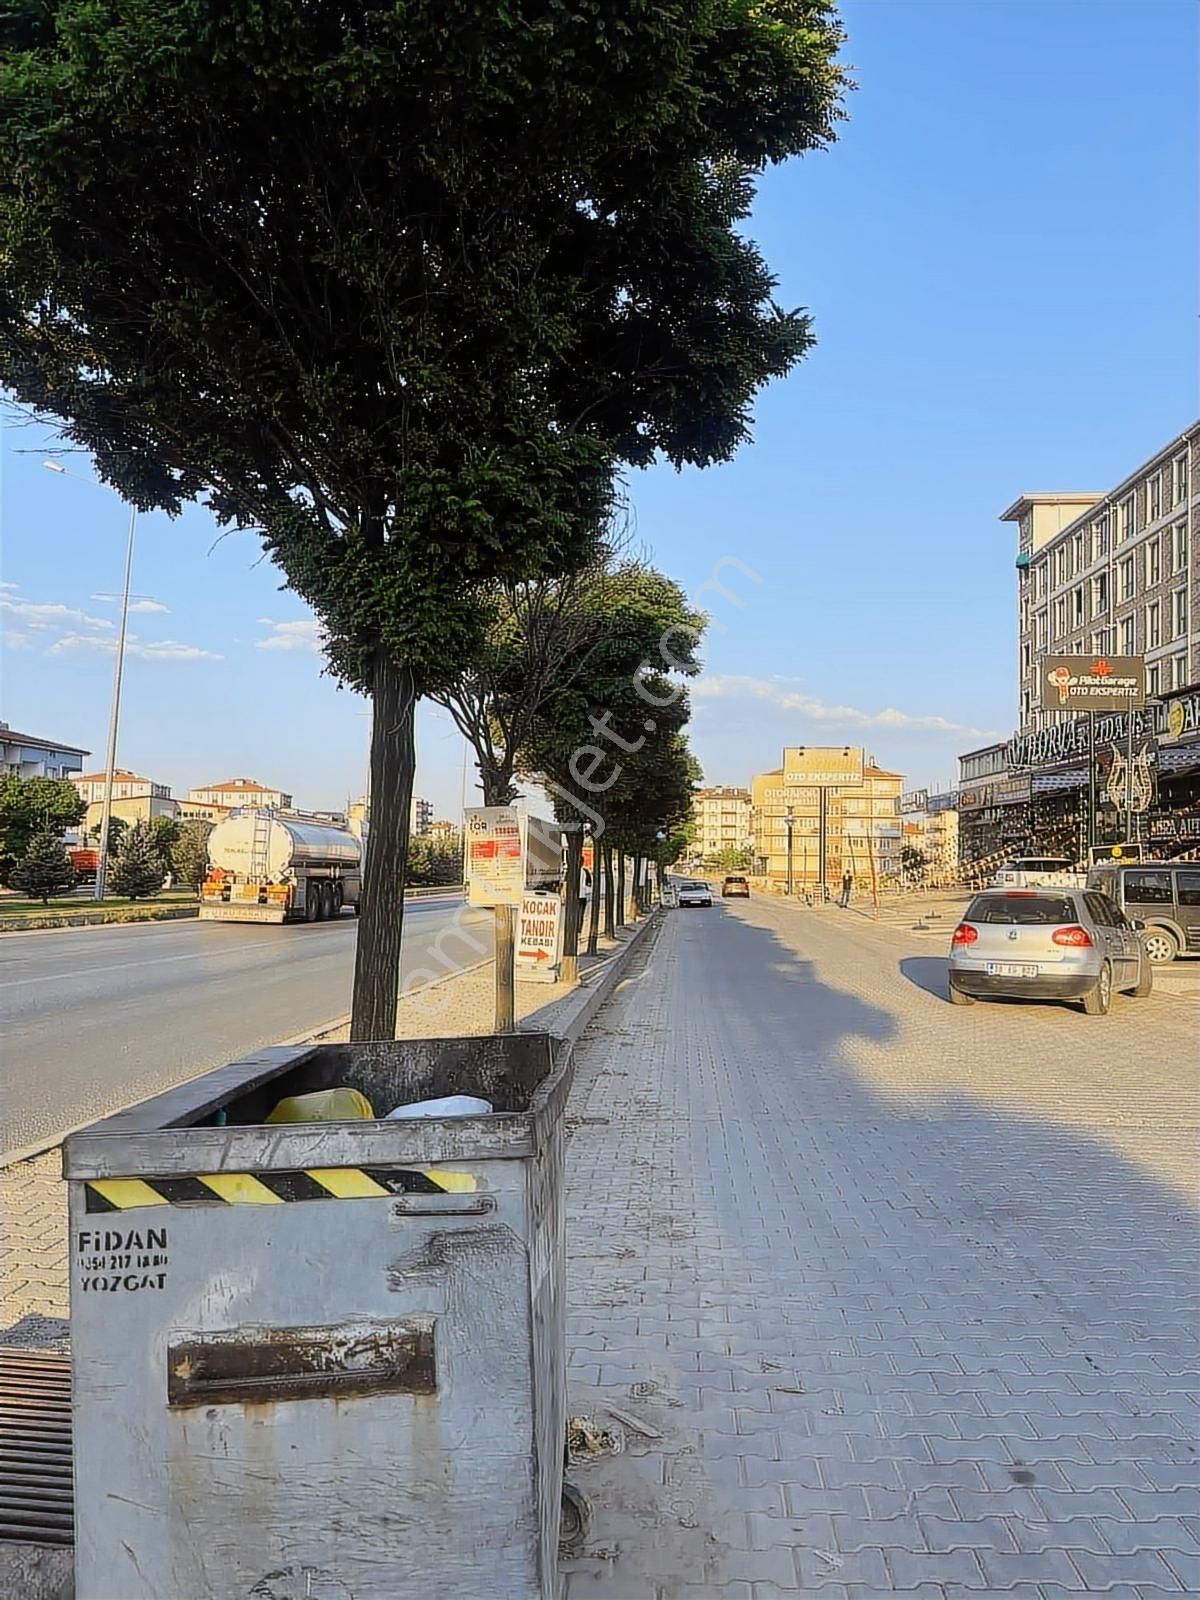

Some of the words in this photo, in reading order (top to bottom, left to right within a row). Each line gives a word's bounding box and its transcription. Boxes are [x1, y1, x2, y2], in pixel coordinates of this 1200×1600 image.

[1070, 686, 1088, 696] OTO
[786, 772, 806, 781] OTO
[520, 918, 556, 938] TANDIR
[110, 1254, 132, 1270] 217
[80, 1273, 167, 1292] YOZGAT
